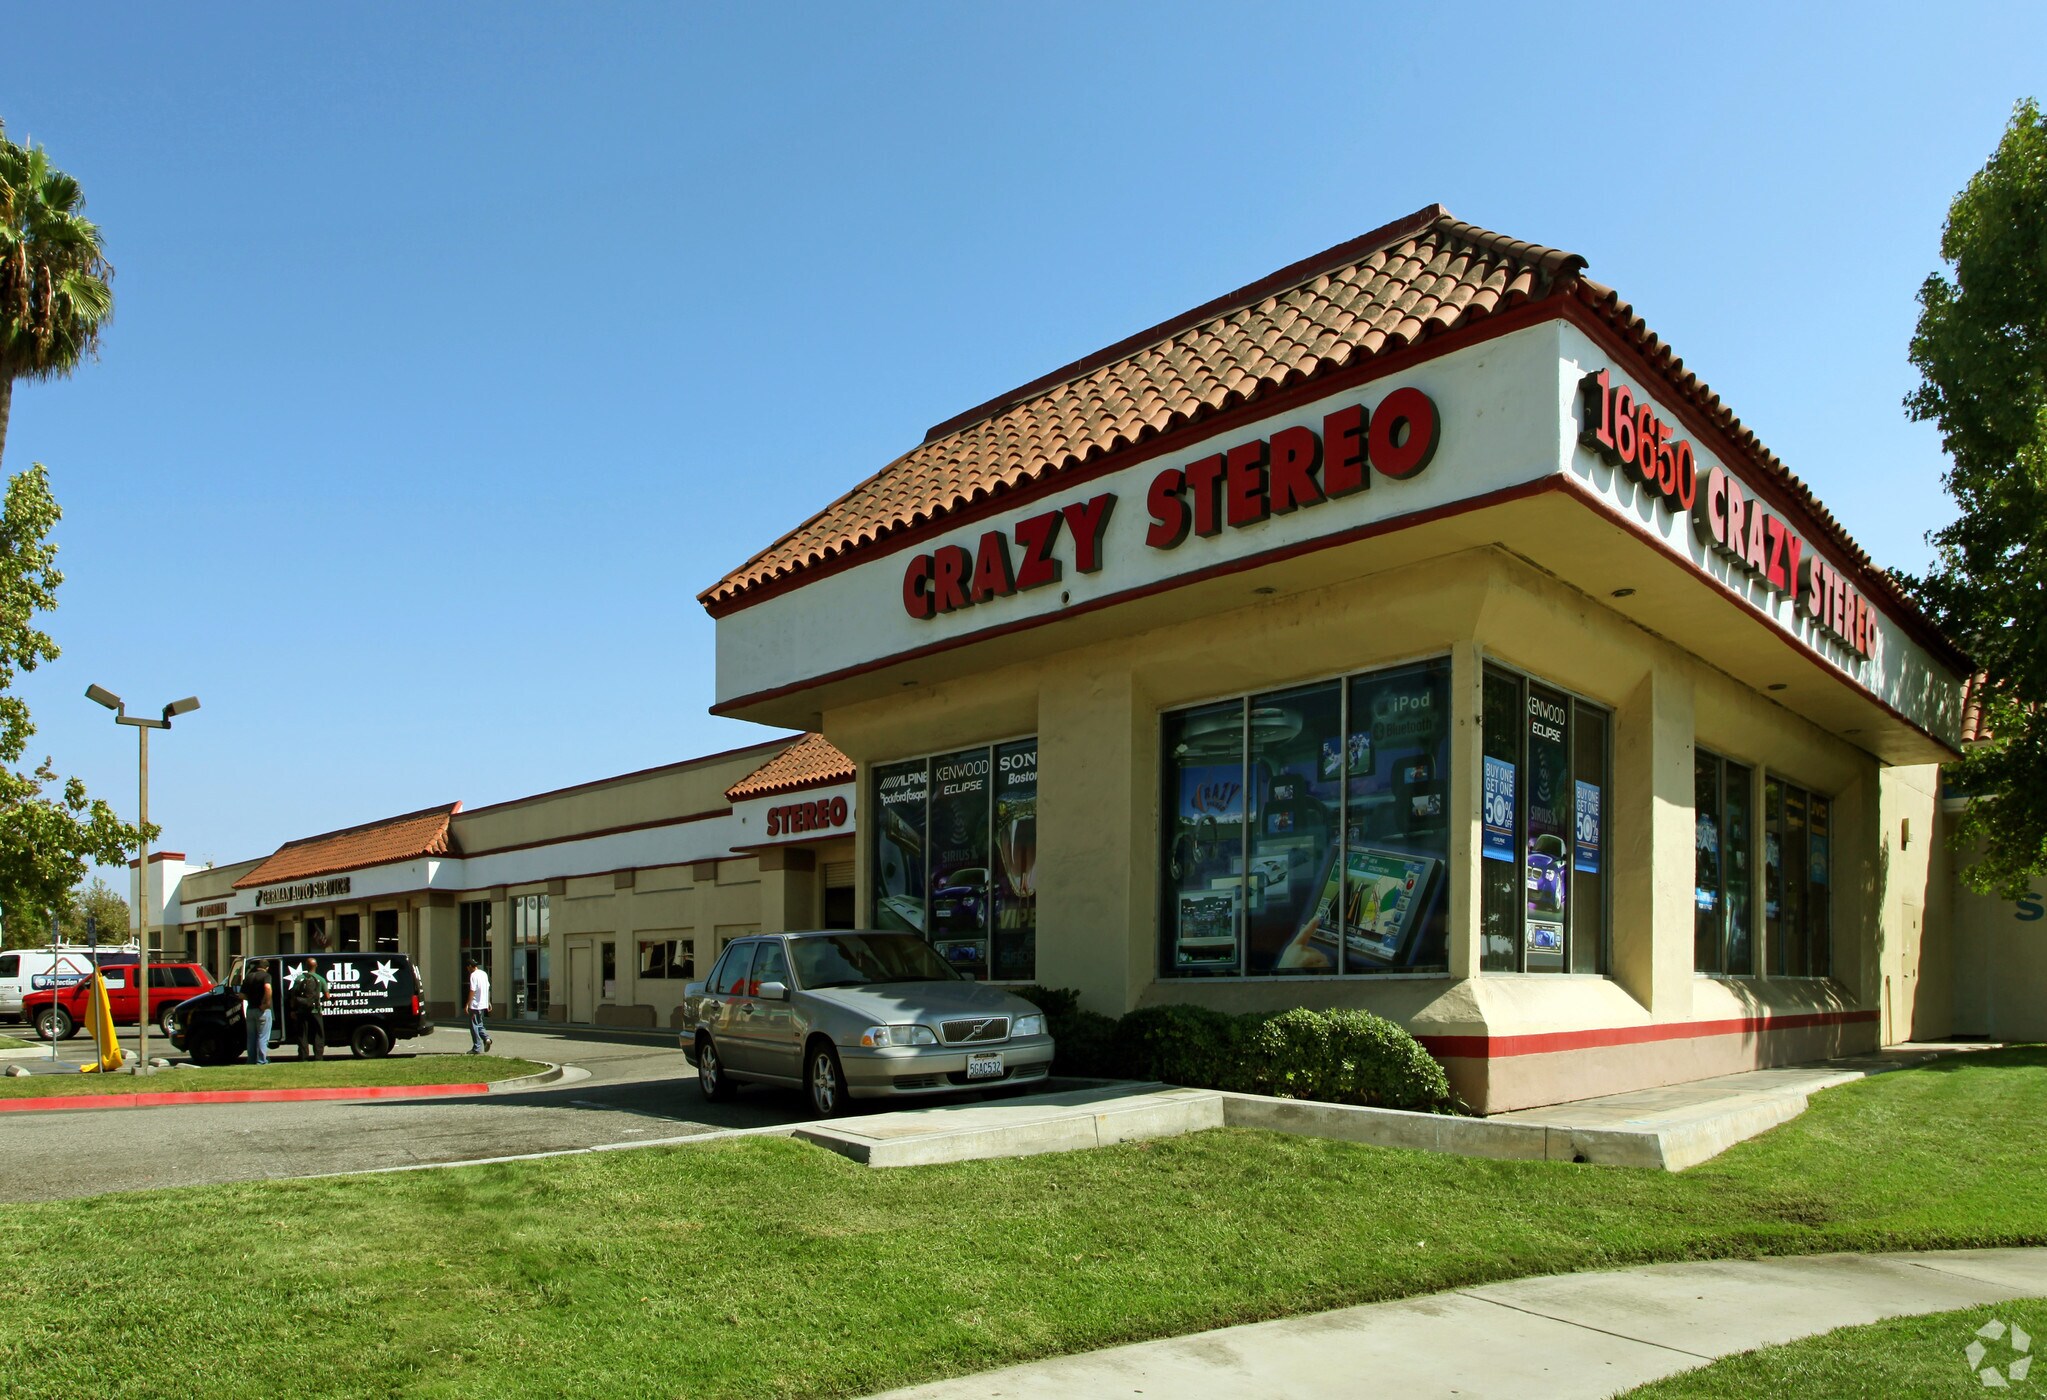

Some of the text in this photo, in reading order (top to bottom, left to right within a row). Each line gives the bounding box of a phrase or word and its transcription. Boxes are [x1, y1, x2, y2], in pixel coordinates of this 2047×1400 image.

[902, 386, 1441, 620] CRAZY STEREO
[1590, 367, 1877, 662] 16650 CRAZY STEREO
[1394, 691, 1430, 712] iPod
[1528, 696, 1566, 726] KENWOOD
[1386, 717, 1432, 737] Bluetooth
[1532, 722, 1561, 743] ECLIPSE
[936, 759, 989, 782] KENWOOD
[999, 752, 1037, 771] SON
[1486, 762, 1513, 784] BUY ONE
[906, 788, 928, 803] Fosgat
[943, 779, 983, 795] ECLIPSE
[1485, 777, 1513, 797] GET ONE
[1577, 786, 1599, 805] BUY ONE
[766, 796, 848, 836] STEREO
[1485, 792, 1513, 826] 50%
[1577, 799, 1599, 816] GET ONE
[1504, 819, 1513, 829] OFF
[1576, 812, 1599, 842] 50%
[942, 848, 970, 863] SIRIUS
[263, 877, 350, 904] GERMAN AUTO SERVICE
[999, 908, 1036, 929] VIPE
[326, 962, 360, 981] db
[355, 990, 388, 998] Training
[970, 1061, 1000, 1074] 5GAC532
